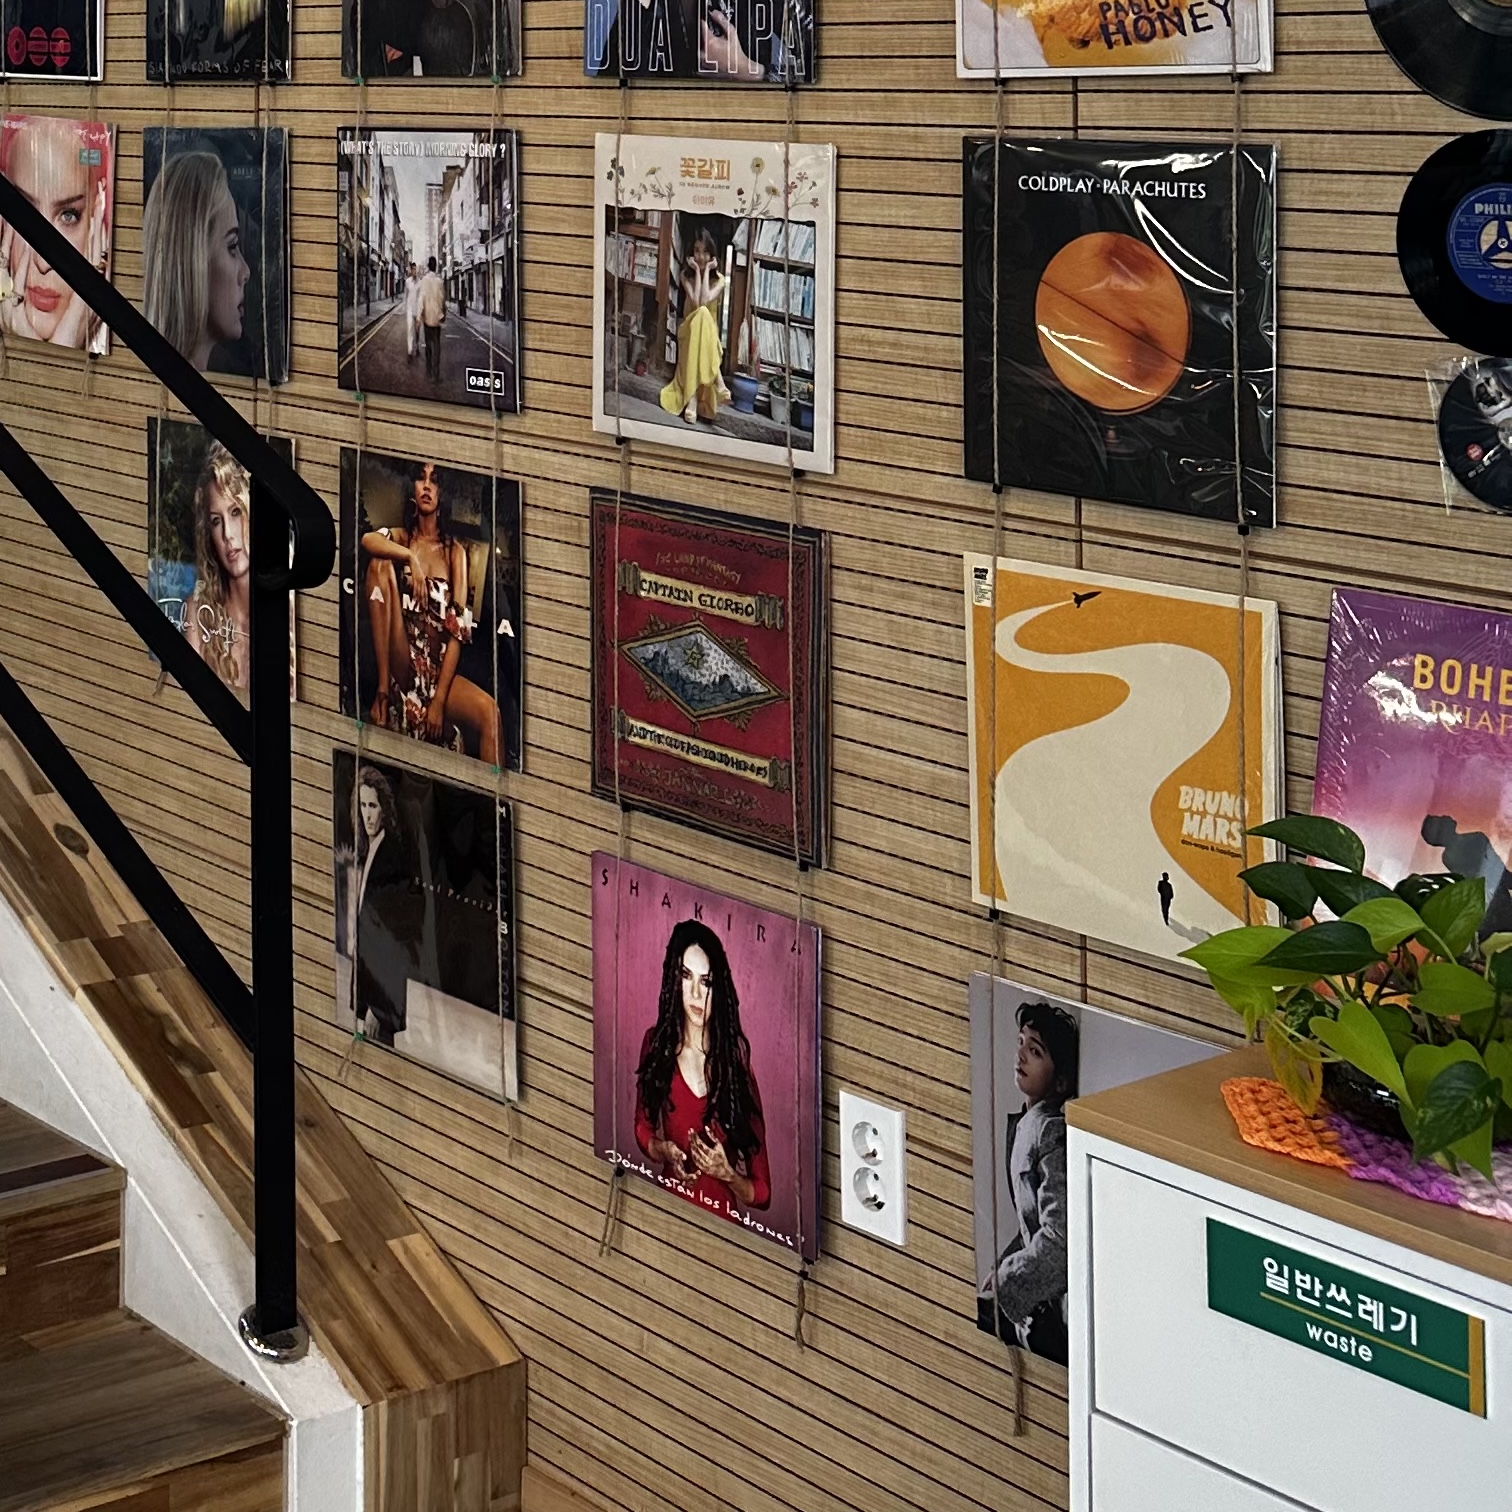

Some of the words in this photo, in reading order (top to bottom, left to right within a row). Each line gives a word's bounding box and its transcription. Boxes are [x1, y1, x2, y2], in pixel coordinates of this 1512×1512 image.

[1018, 175, 1094, 194] COLDPLAY
[1102, 177, 1207, 200] PARACHUTES
[469, 375, 501, 389] oass
[639, 579, 694, 604] CAPTAIN
[1178, 784, 1250, 821] BRUNO
[1181, 811, 1244, 849] MARS
[600, 867, 805, 956] SHAKIRA
[604, 1149, 654, 1179] Dónde
[699, 1189, 720, 1210] los
[1262, 1256, 1418, 1347] 일반쓰레기
[1305, 1321, 1373, 1363] waste
